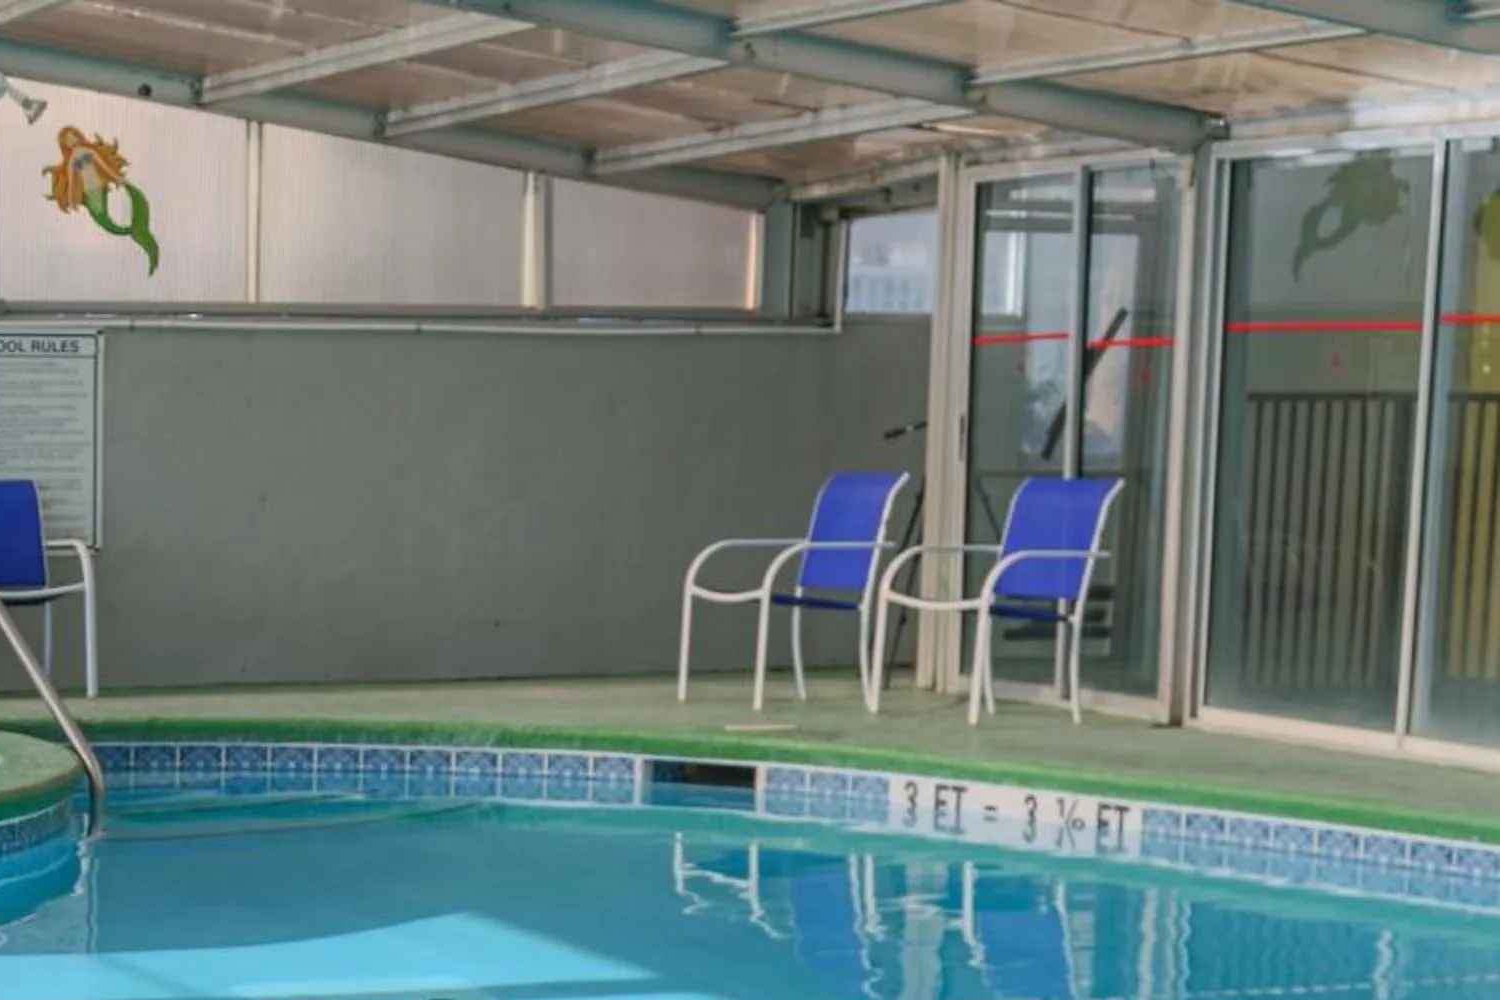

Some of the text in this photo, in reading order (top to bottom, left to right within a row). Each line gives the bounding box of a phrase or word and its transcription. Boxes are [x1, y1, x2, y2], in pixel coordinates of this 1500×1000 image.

[31, 339, 80, 353] RULES
[933, 784, 968, 821] FT
[1097, 802, 1132, 838] FT
